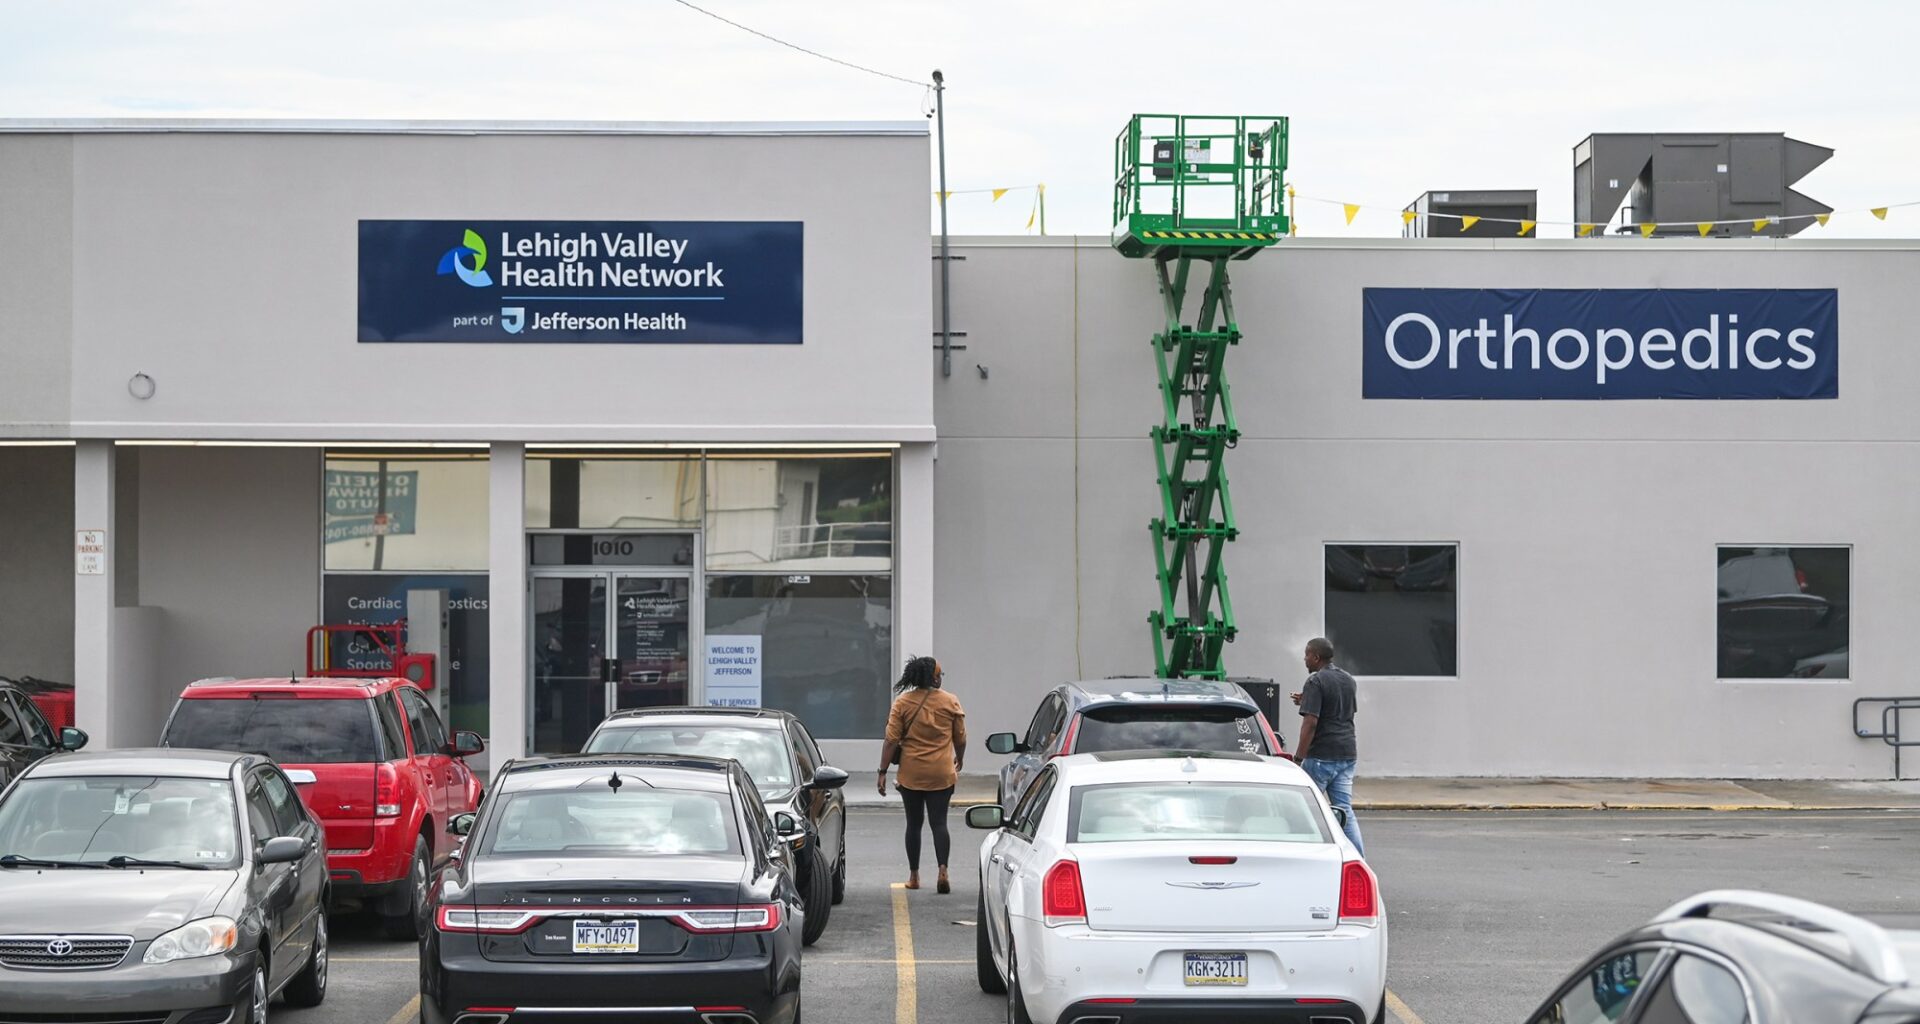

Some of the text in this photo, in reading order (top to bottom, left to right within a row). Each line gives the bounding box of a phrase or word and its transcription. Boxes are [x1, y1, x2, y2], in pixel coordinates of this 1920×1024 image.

[501, 232, 688, 263] Lehigh Valley
[501, 262, 724, 288] Health Network
[453, 312, 687, 331] part of Jefferson Health
[1384, 312, 1817, 384] Orthopedics
[85, 534, 96, 544] NO
[78, 544, 104, 553] PARKING
[593, 540, 634, 556] 1010
[347, 596, 402, 609] Cardiac
[711, 646, 755, 654] WELCOME TO
[708, 657, 757, 665] LEHIGH VALLEY
[714, 667, 752, 675] JEFFERSON
[729, 698, 758, 706] SERVICES
